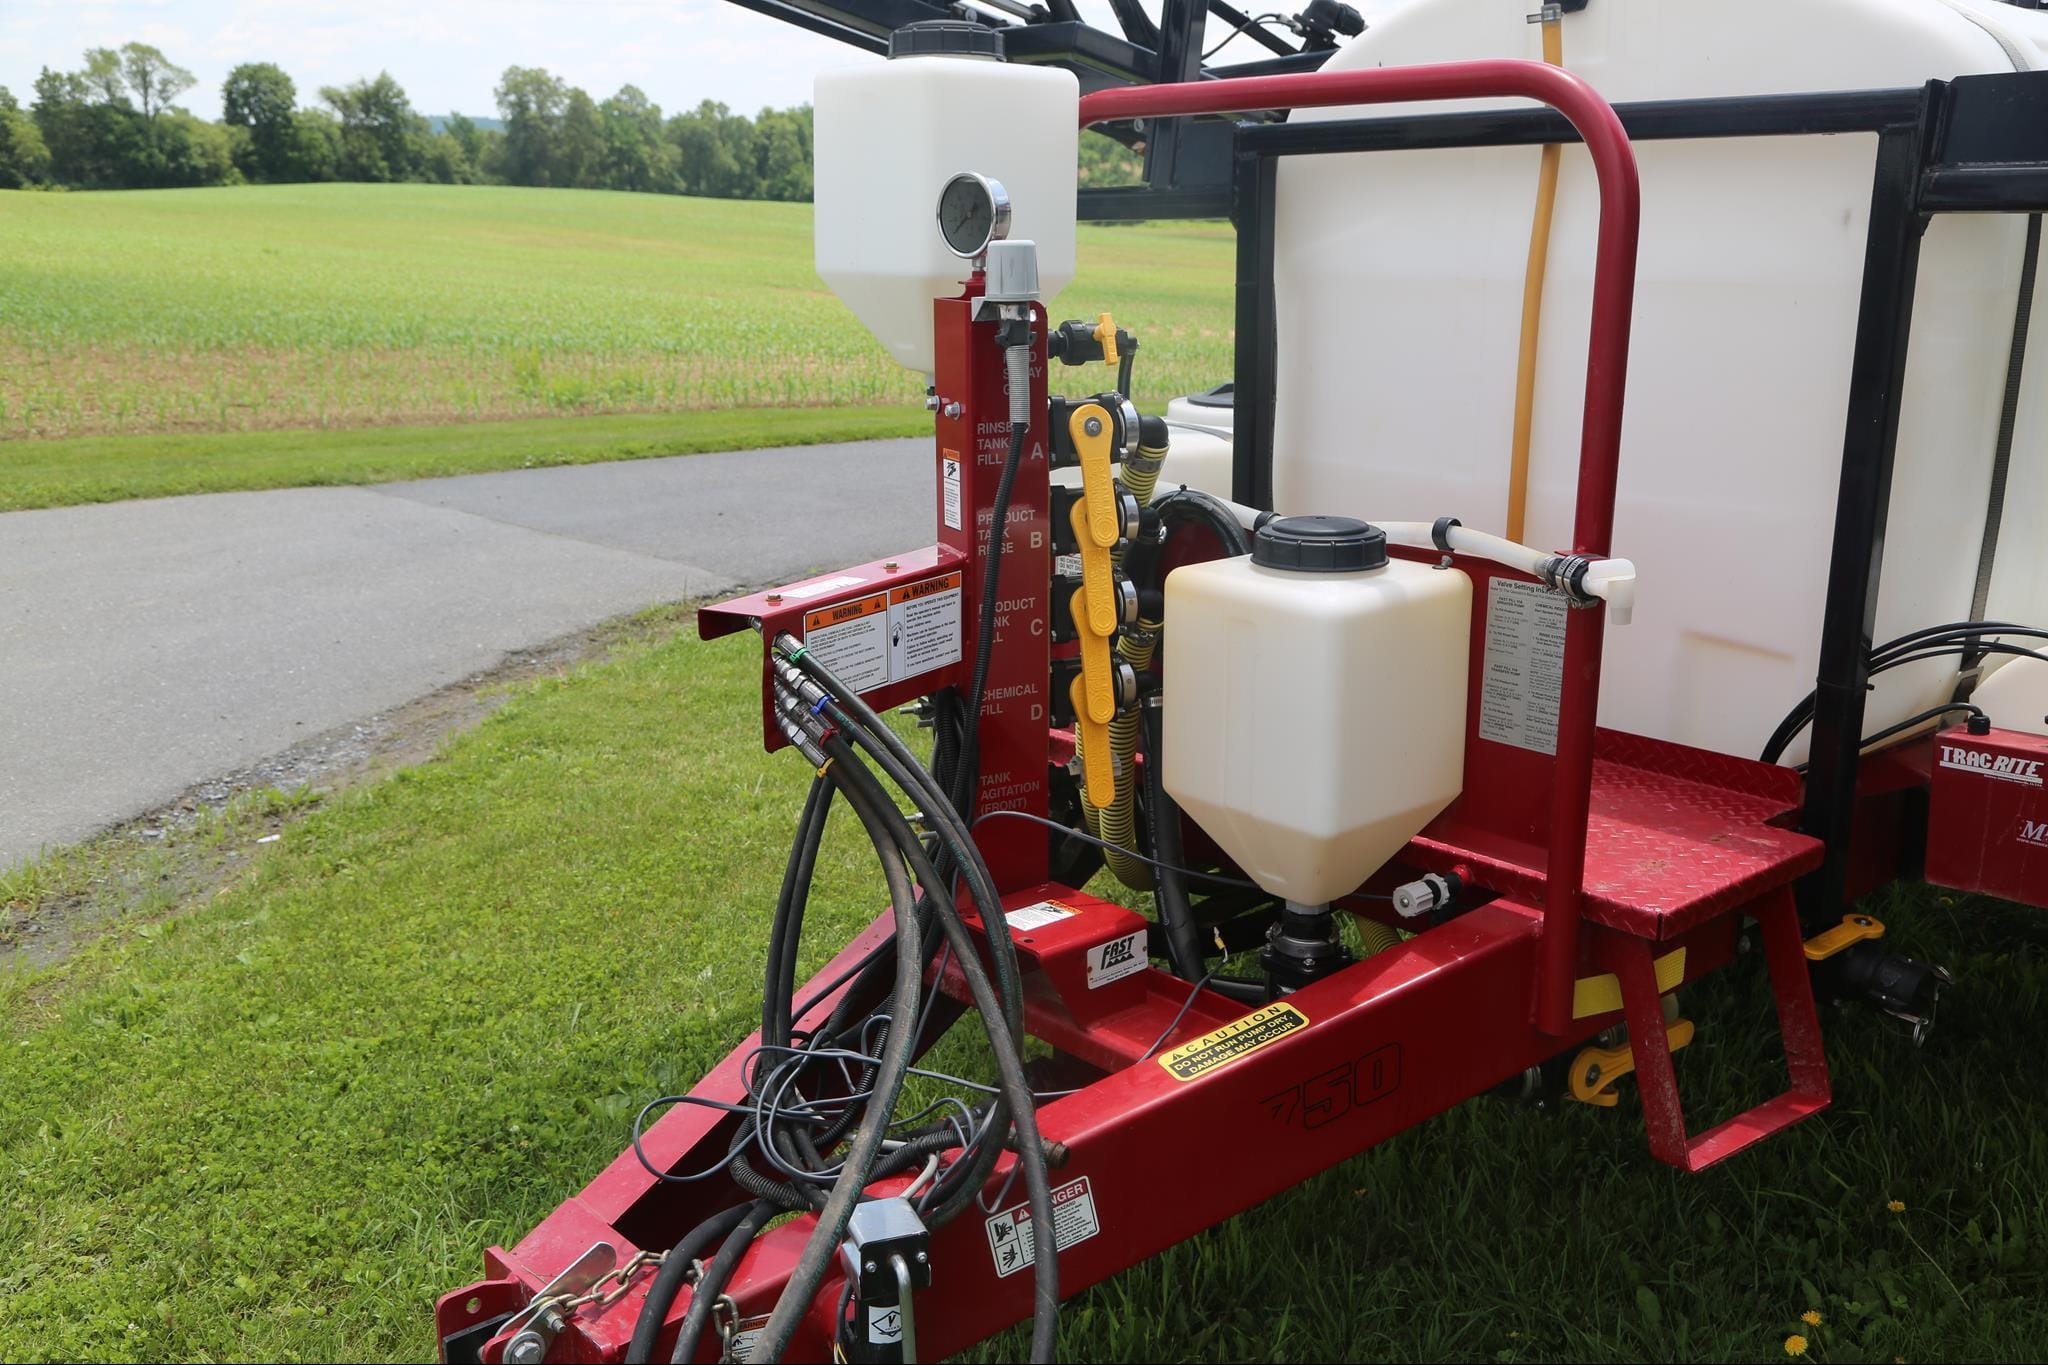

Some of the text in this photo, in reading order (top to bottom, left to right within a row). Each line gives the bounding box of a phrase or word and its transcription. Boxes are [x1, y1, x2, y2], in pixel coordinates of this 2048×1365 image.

[1003, 366, 1042, 380] SAY
[977, 438, 1009, 450] TANK
[1031, 442, 1044, 460] A
[978, 454, 1002, 466] FILL
[978, 510, 1036, 525] PRDUCT
[978, 528, 1010, 540] TAK
[1030, 532, 1042, 548] B
[978, 542, 1014, 556] RISE
[912, 578, 949, 596] WARNING
[1513, 583, 1534, 592] Setting
[832, 604, 862, 620] WARNING
[979, 598, 1036, 614] ODUCT
[1030, 618, 1044, 636] C
[980, 704, 1004, 716] FILL
[1031, 704, 1043, 720] D
[1992, 755, 2044, 778] RITE
[981, 772, 1011, 786] TANK
[981, 781, 1040, 800] AGITATION
[2020, 820, 2048, 842] M
[1100, 936, 1134, 970] FAST
[1186, 1006, 1281, 1053] CAUTION
[1174, 1060, 1192, 1072] DO
[1192, 1049, 1215, 1066] NOT
[1214, 1040, 1238, 1056] RUN
[1238, 1026, 1266, 1042] PUMP
[1188, 1021, 1296, 1074] DAMAGE MAY OCCUR
[1259, 1042, 1403, 1130] 750
[1051, 1184, 1084, 1205] NGER
